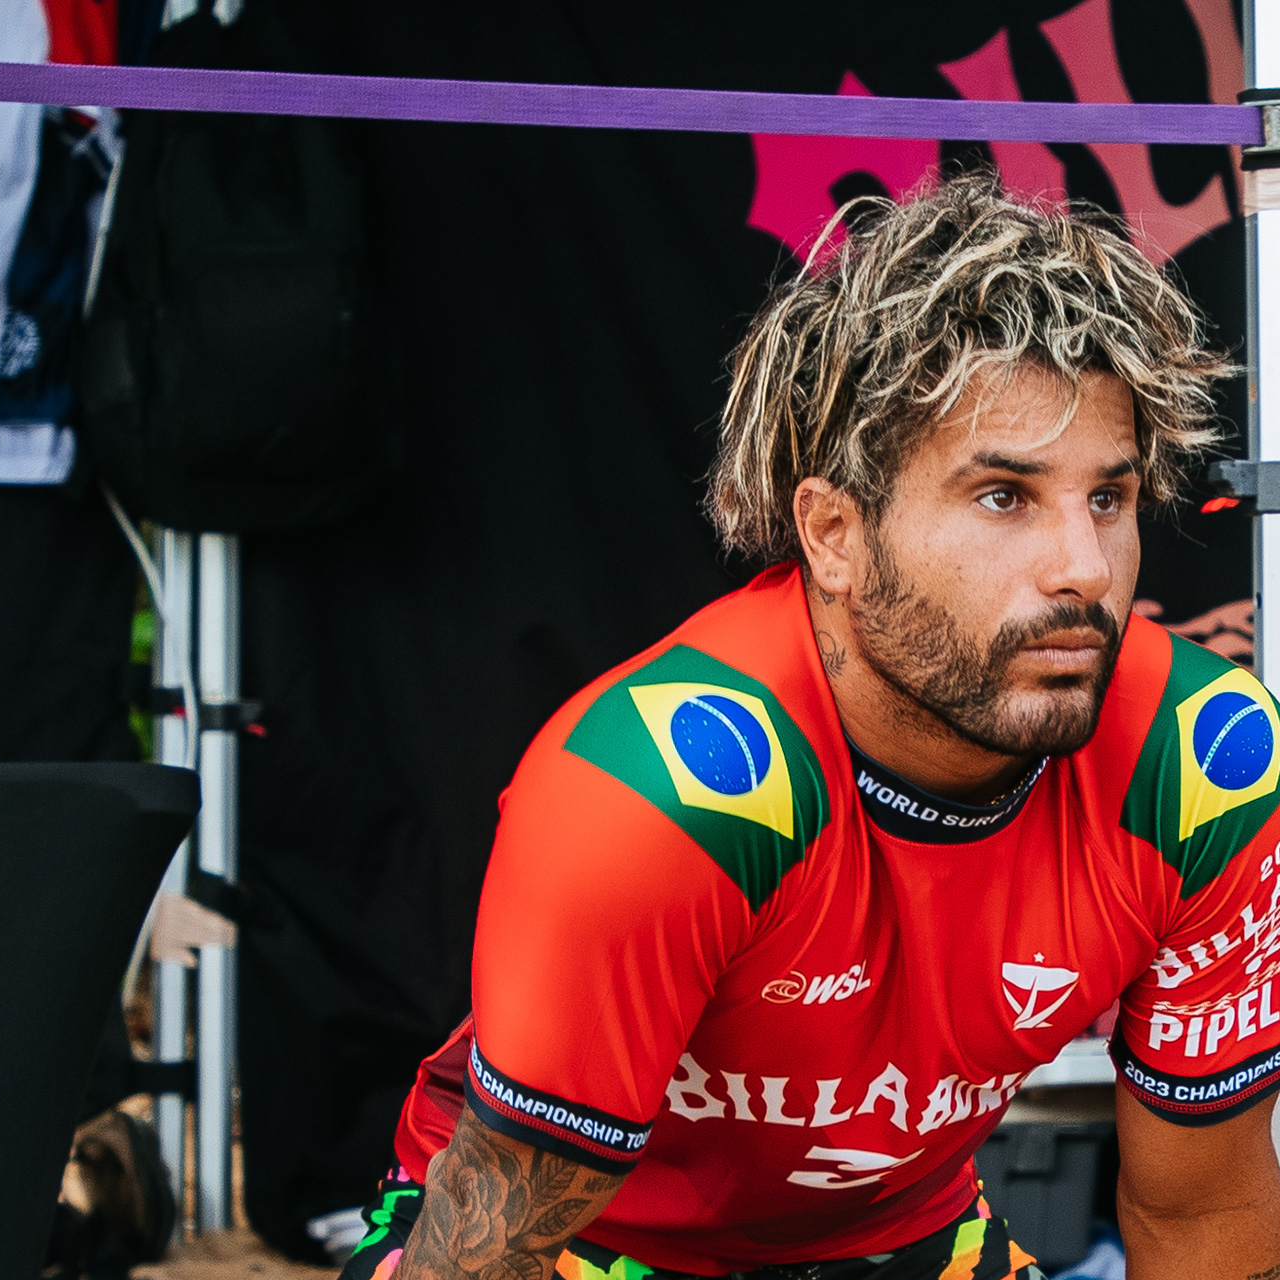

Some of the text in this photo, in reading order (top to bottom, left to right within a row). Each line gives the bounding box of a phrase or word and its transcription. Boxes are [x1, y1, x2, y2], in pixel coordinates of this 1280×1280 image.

[856, 769, 940, 822] WORLD
[802, 960, 872, 1005] WSL
[1124, 1060, 1171, 1097] 2023
[481, 1070, 625, 1145] CHAMPIONSHIP
[626, 1126, 652, 1149] TOU
